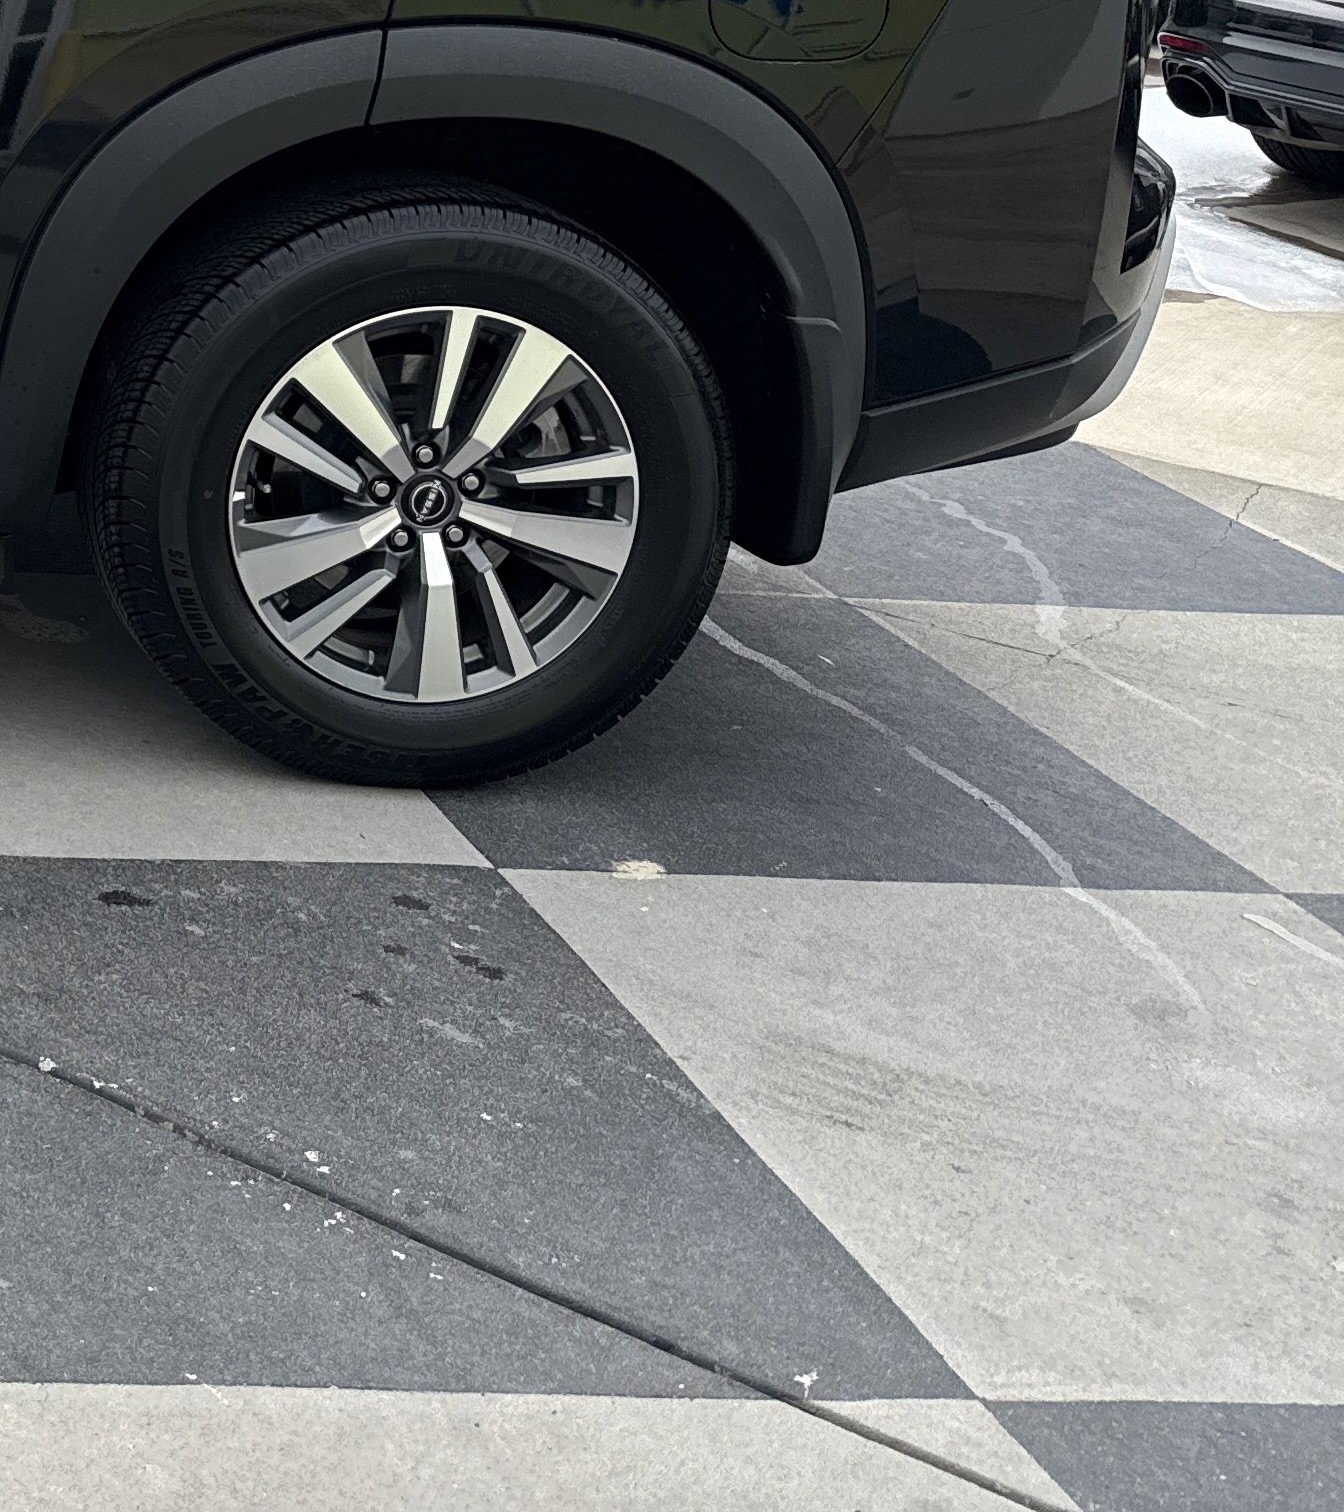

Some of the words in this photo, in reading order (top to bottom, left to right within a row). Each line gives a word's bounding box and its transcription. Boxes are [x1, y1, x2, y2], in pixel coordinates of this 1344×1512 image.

[454, 236, 674, 365] UNIROYAL
[416, 479, 442, 523] NISSAN
[174, 583, 218, 653] TOURING
[211, 655, 289, 727] PAW
